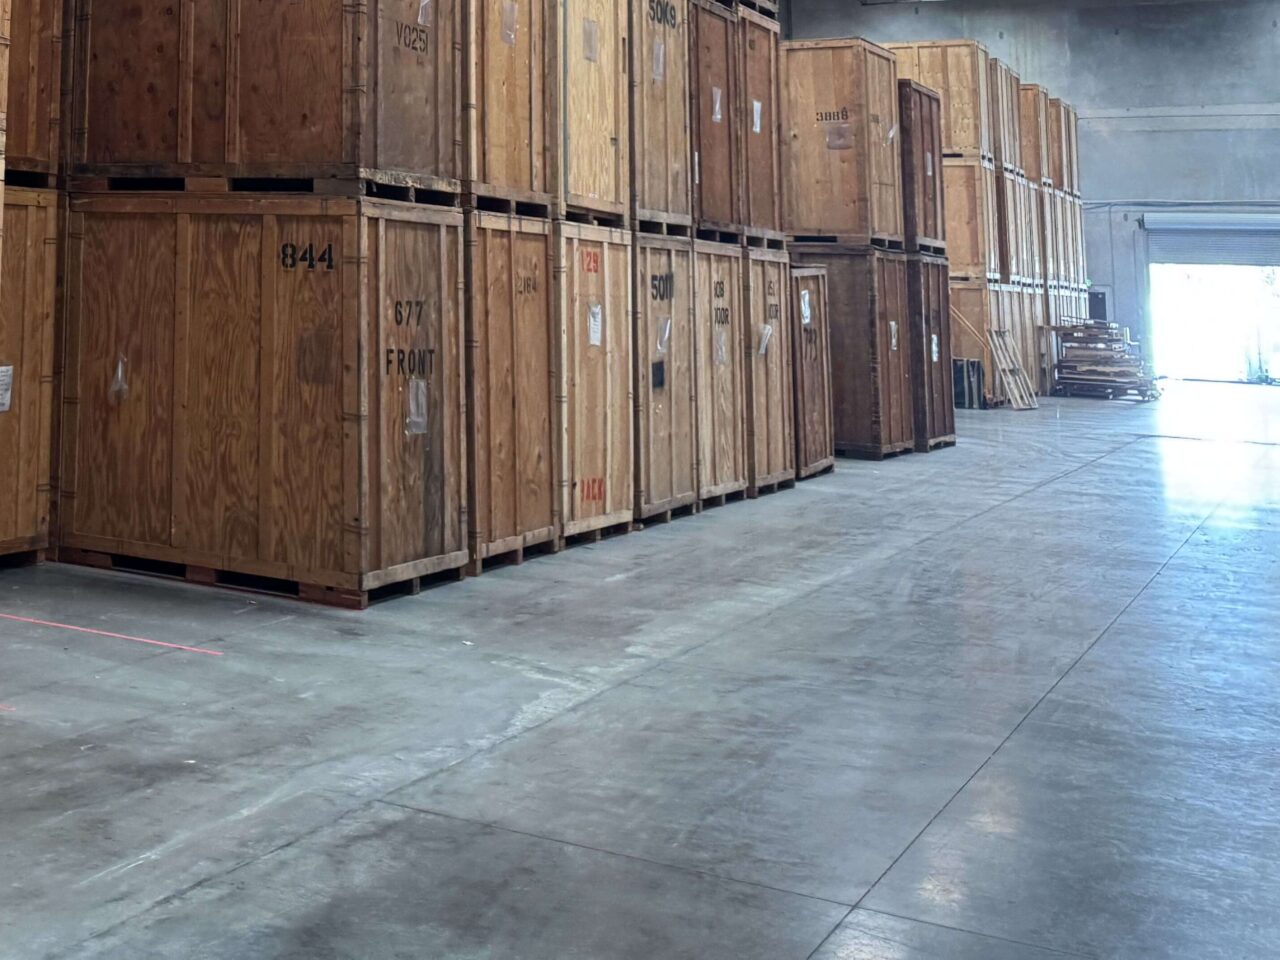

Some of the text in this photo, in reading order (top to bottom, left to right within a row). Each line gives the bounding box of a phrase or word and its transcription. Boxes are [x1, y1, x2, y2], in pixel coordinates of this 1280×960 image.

[280, 243, 334, 271] 844
[394, 301, 423, 326] 677
[385, 349, 435, 375] FRONT
